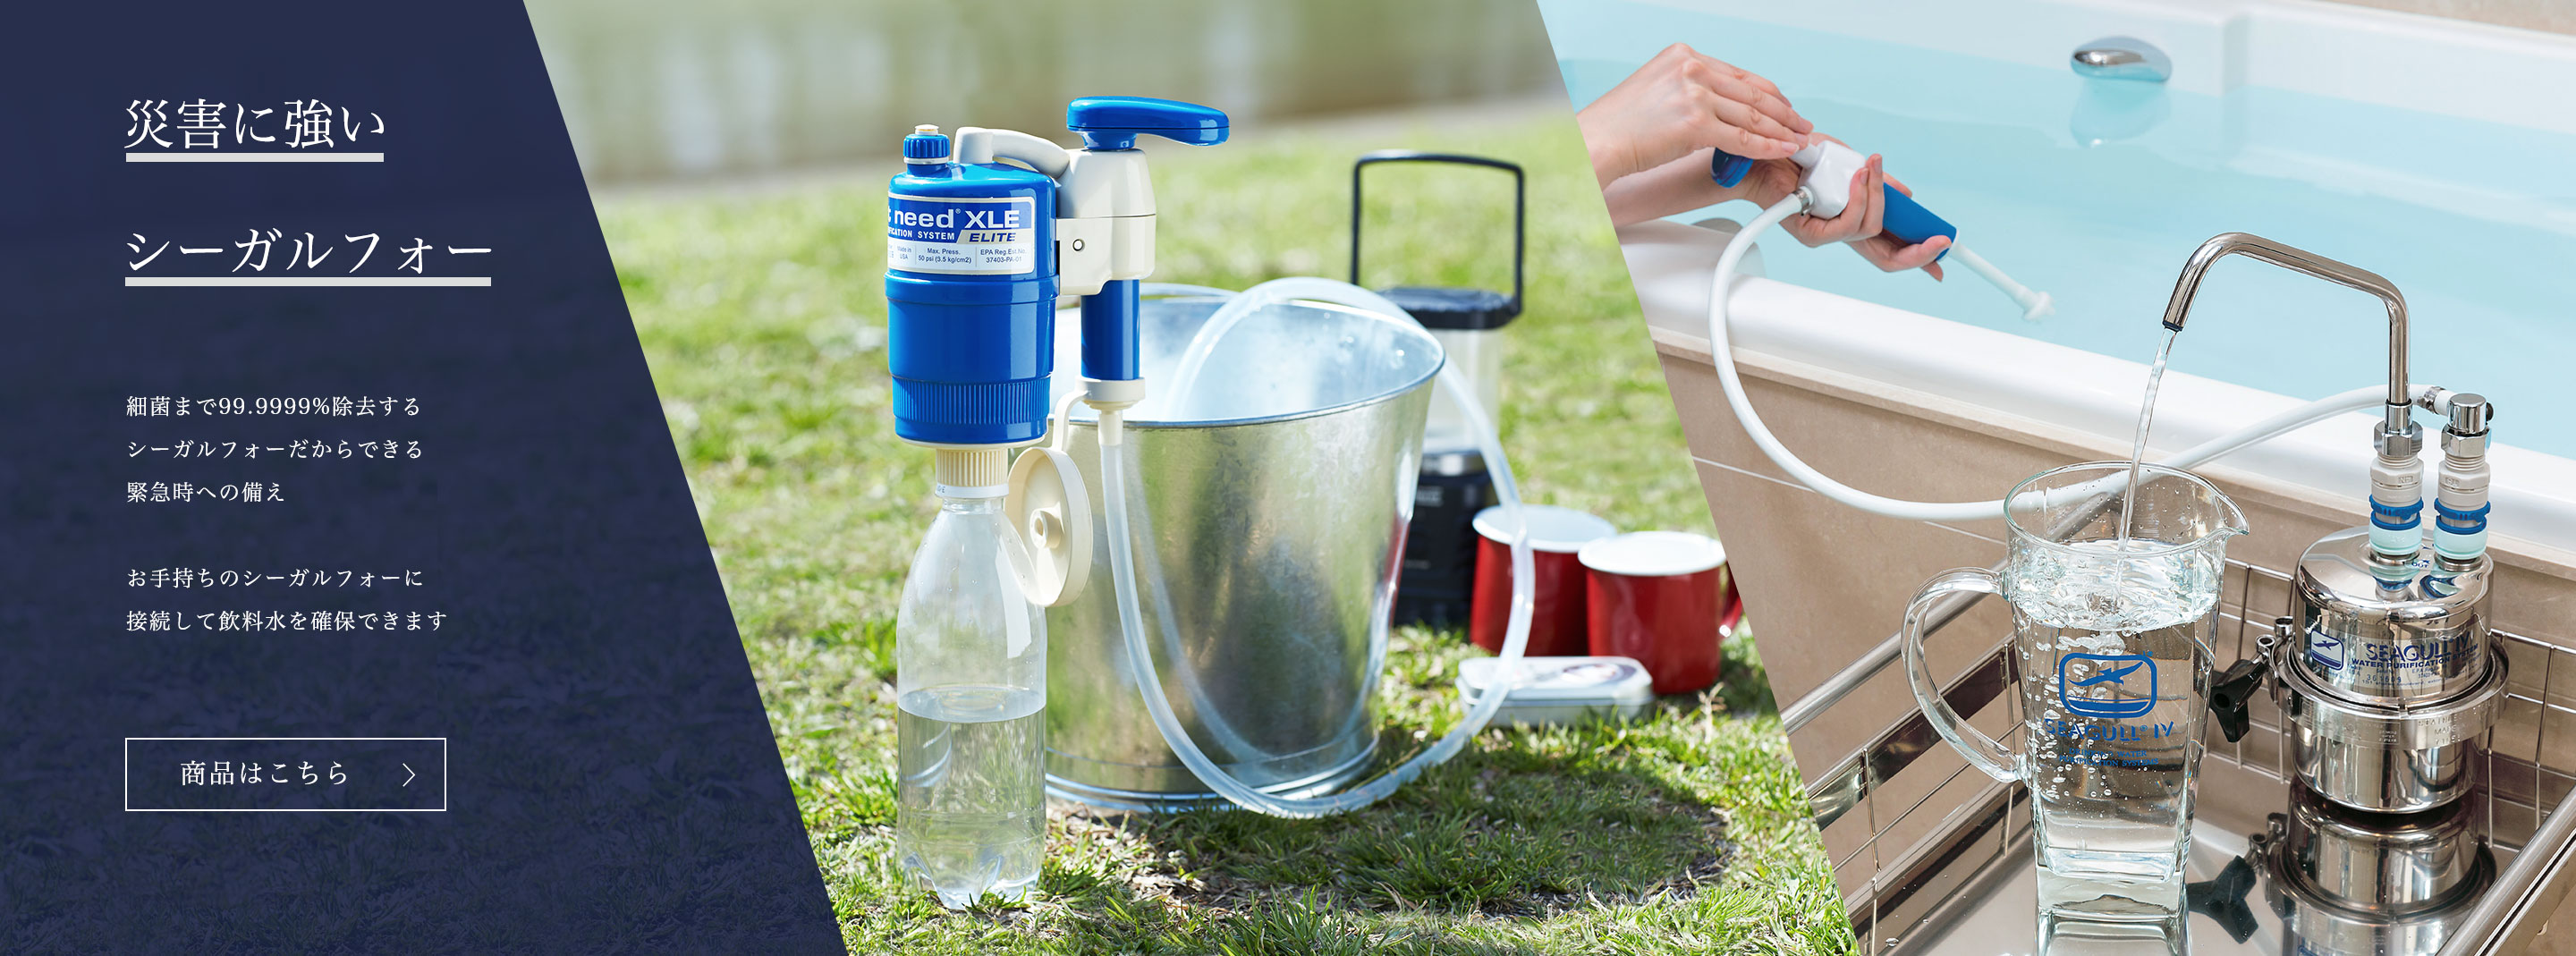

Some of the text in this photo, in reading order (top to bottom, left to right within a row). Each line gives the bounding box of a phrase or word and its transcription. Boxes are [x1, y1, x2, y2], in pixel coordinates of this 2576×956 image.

[964, 209, 1020, 229] XLE
[917, 231, 955, 241] SYSTEM
[969, 233, 1016, 242] ELITE
[2411, 561, 2429, 569] OUT
[2351, 657, 2384, 668] WATER
[2386, 656, 2451, 669] PURIFICATION
[2153, 720, 2175, 740] IV
[2116, 750, 2148, 758] WATER
[2122, 757, 2159, 767] SYSTEMS
